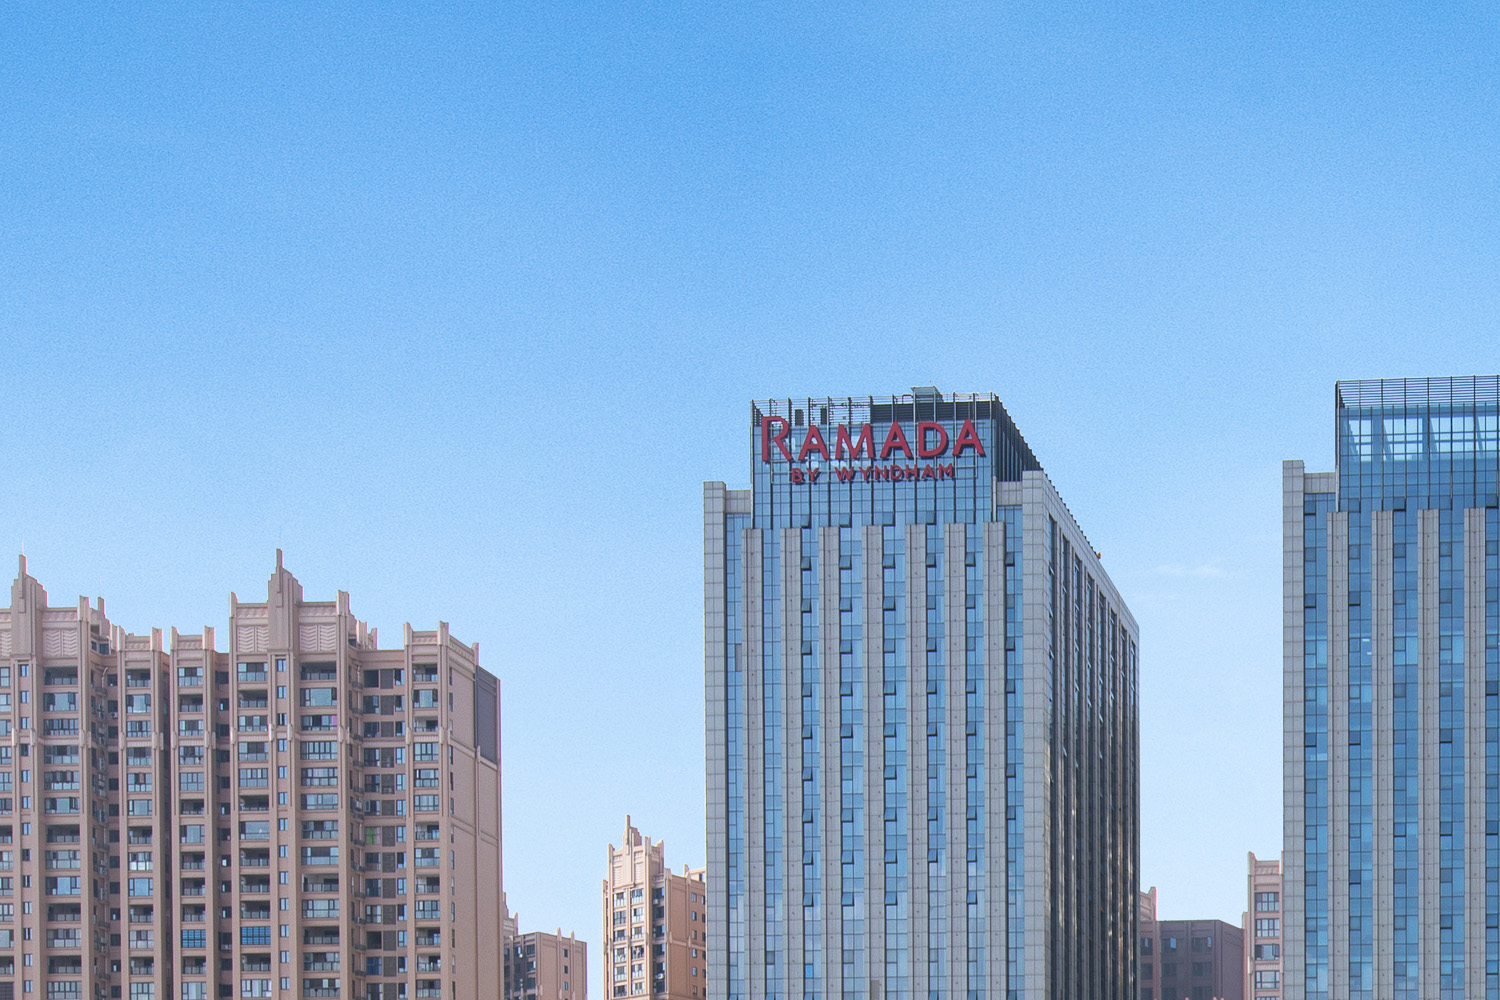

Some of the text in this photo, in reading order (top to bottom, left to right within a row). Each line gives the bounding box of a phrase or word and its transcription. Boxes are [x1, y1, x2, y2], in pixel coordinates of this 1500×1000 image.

[761, 416, 986, 462] RAMADA
[791, 463, 954, 483] BY WYNDHAM
